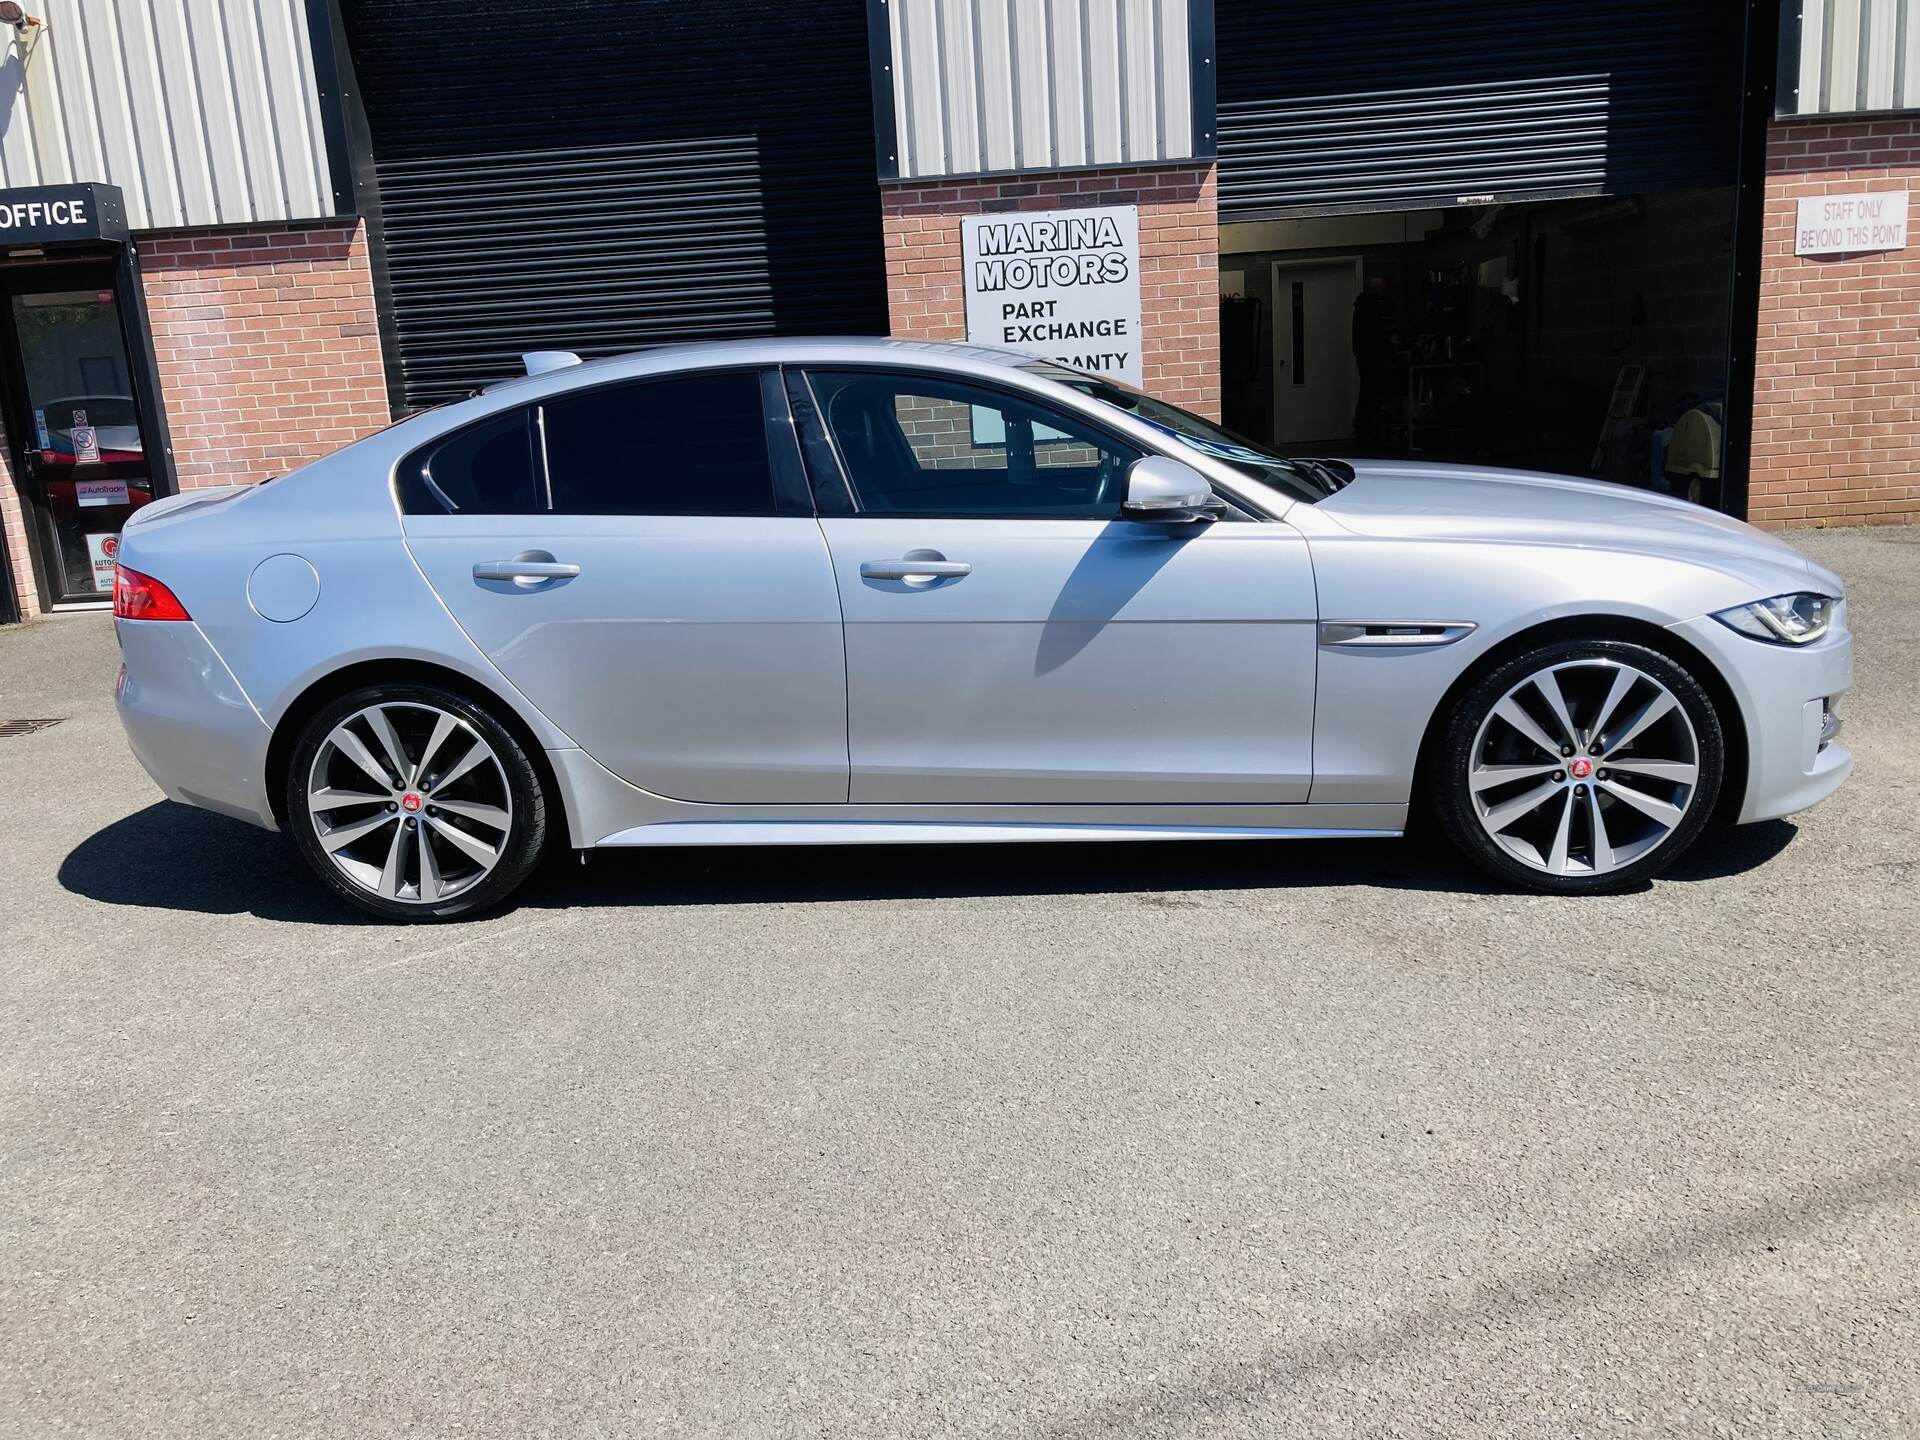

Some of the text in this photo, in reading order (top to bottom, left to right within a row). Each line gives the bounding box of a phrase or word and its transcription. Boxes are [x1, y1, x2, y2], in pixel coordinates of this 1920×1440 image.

[0, 200, 87, 228] OFFICE
[1824, 200, 1883, 222] STAFF ONLY
[978, 217, 1122, 256] MARINA
[1800, 224, 1902, 248] BEYOND THIS POINT
[975, 253, 1129, 292] MOTORS
[1003, 300, 1057, 320] PART
[1003, 319, 1127, 343] EXCHANGE
